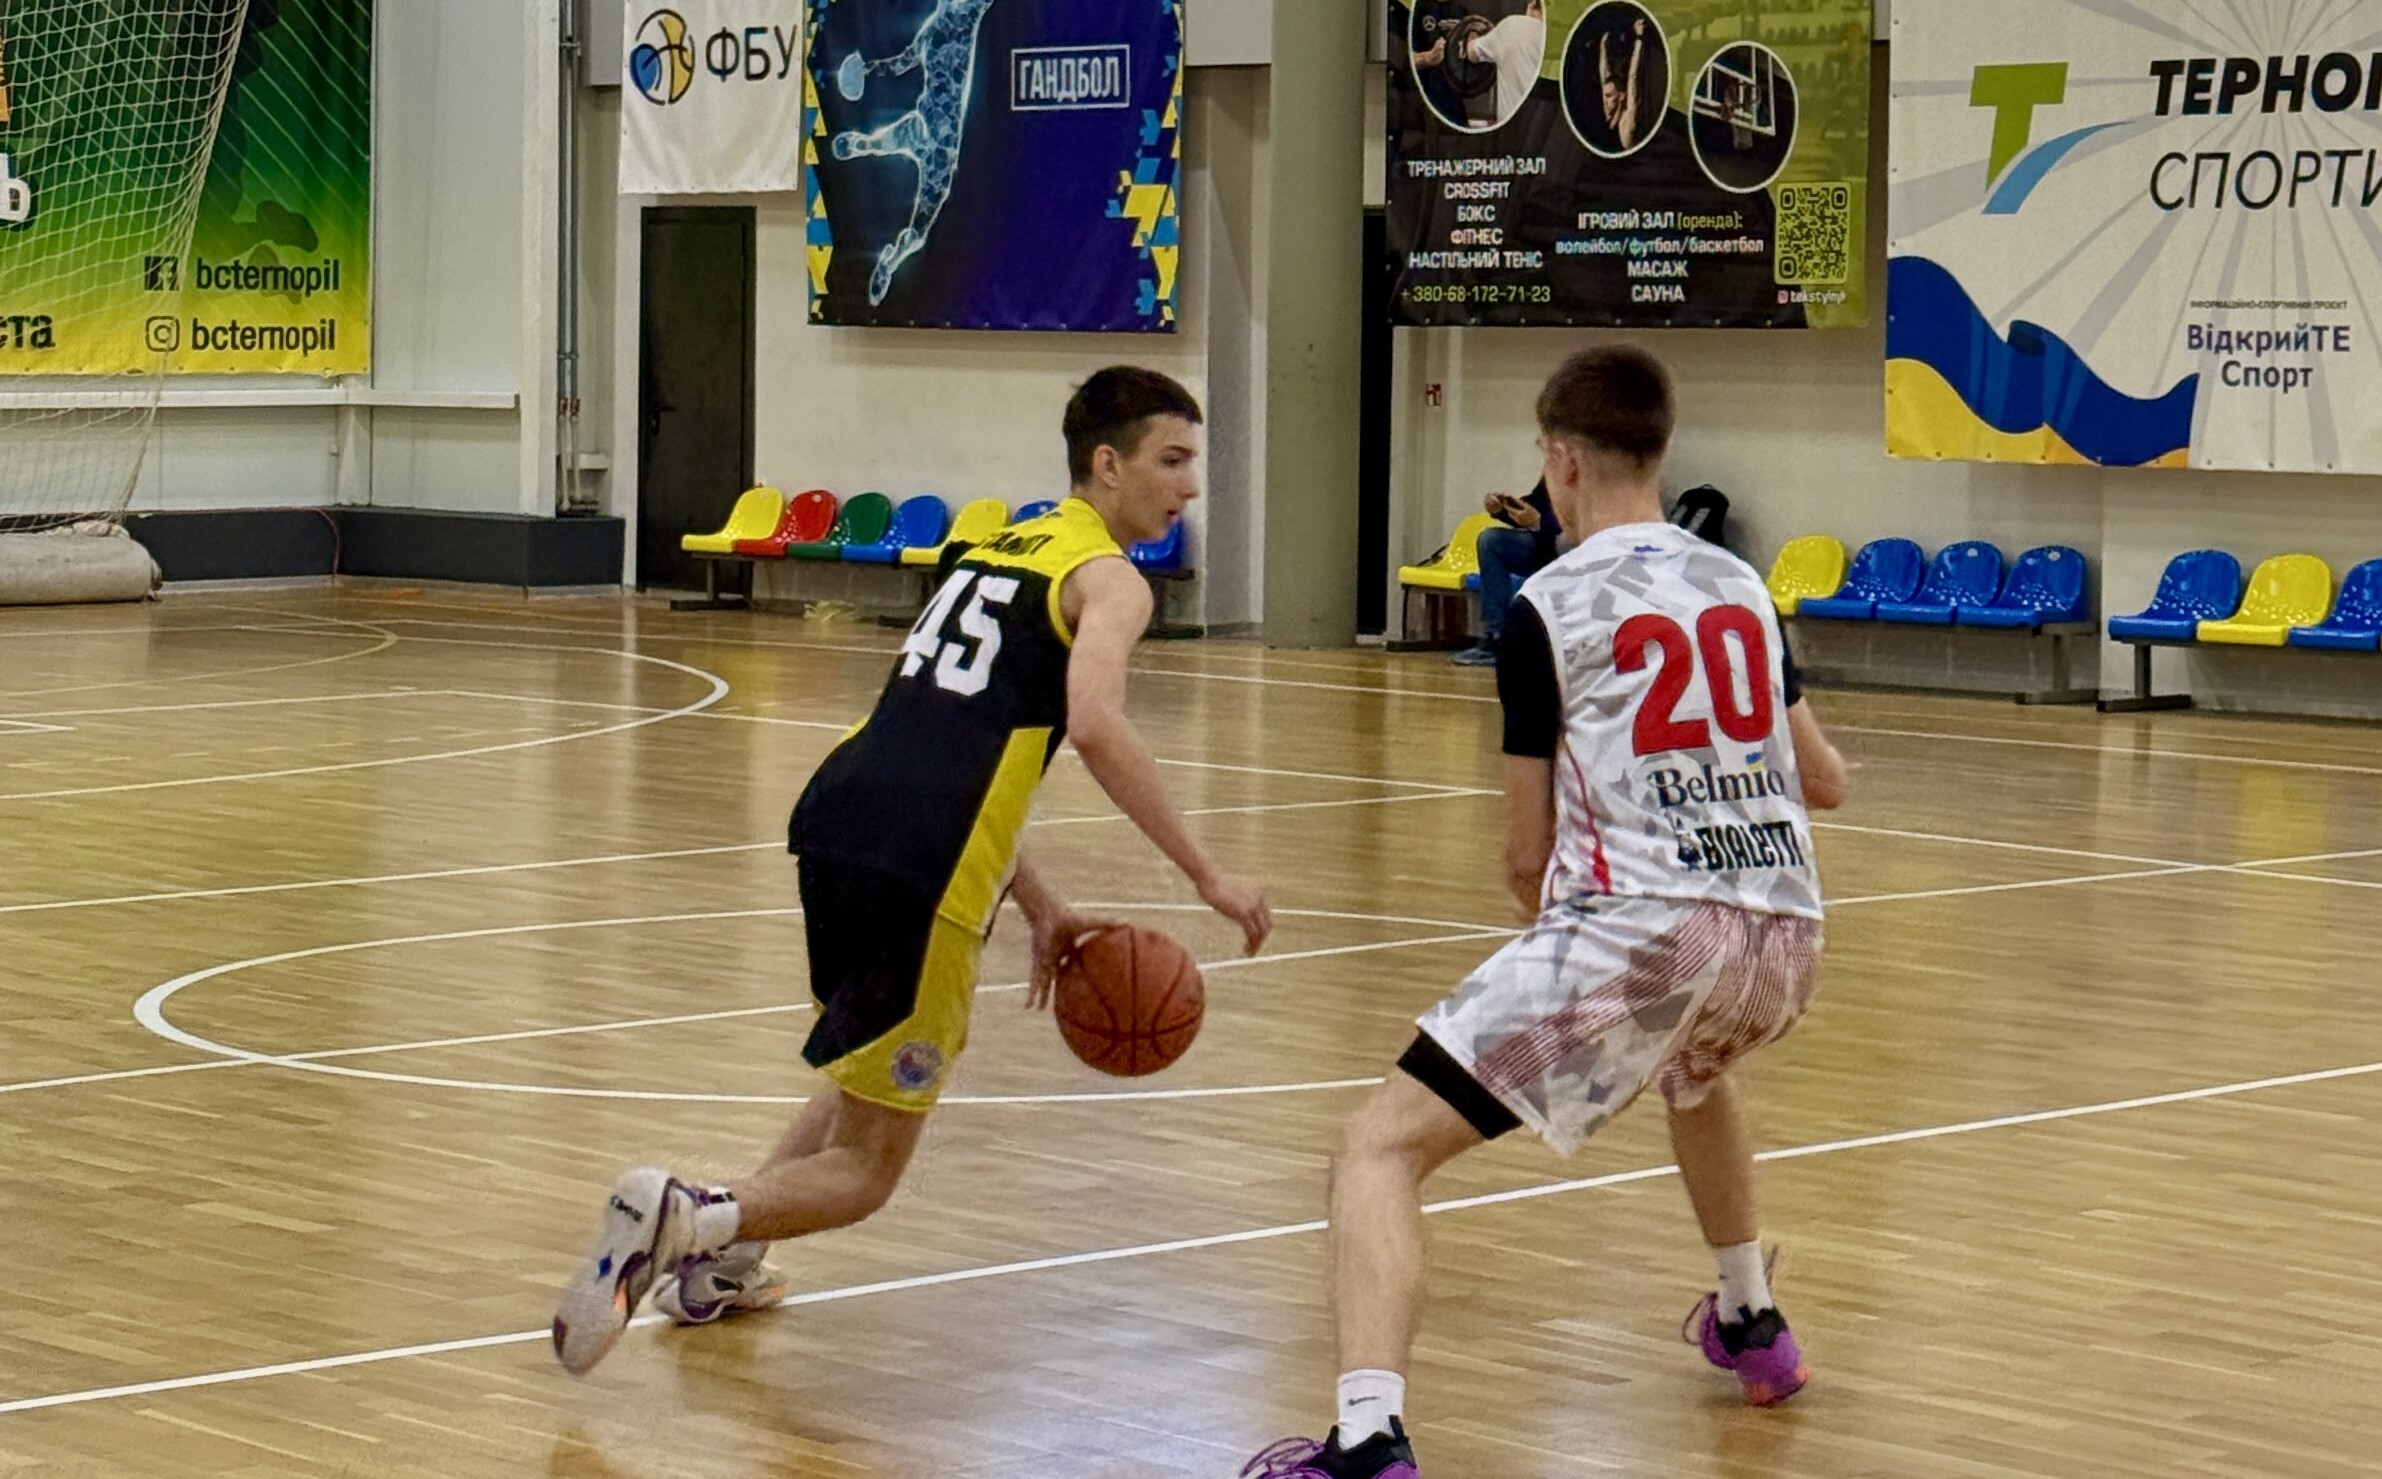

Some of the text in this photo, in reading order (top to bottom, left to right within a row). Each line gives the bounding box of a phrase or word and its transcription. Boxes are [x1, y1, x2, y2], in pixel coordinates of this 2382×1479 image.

[705, 24, 798, 83] ФБУ
[1019, 56, 1120, 103] ГАНДБОЛ
[1407, 155, 1546, 177] ТРЕНАЖЕРНИЙ ЗАЛ
[1444, 181, 1511, 199] CROSSFIT
[1457, 205, 1496, 222] БОКС
[1577, 209, 1639, 230] ІГРОВИЙ
[1642, 211, 1674, 229] ЗАЛ
[1450, 228, 1504, 245] ФІТНЕС
[1409, 249, 1500, 269] НАСТІЛЬНИЙ
[1627, 260, 1688, 278] МАСАЖ
[196, 257, 339, 297] bcternopil
[1631, 284, 1685, 302] САУНА
[191, 317, 335, 357] bcternopil
[2187, 322, 2351, 358] ВідкрийТЕ
[2221, 360, 2313, 394] Спорт
[901, 568, 1022, 696] 45
[1613, 604, 1775, 757] 20
[1646, 763, 1786, 808] Belmio
